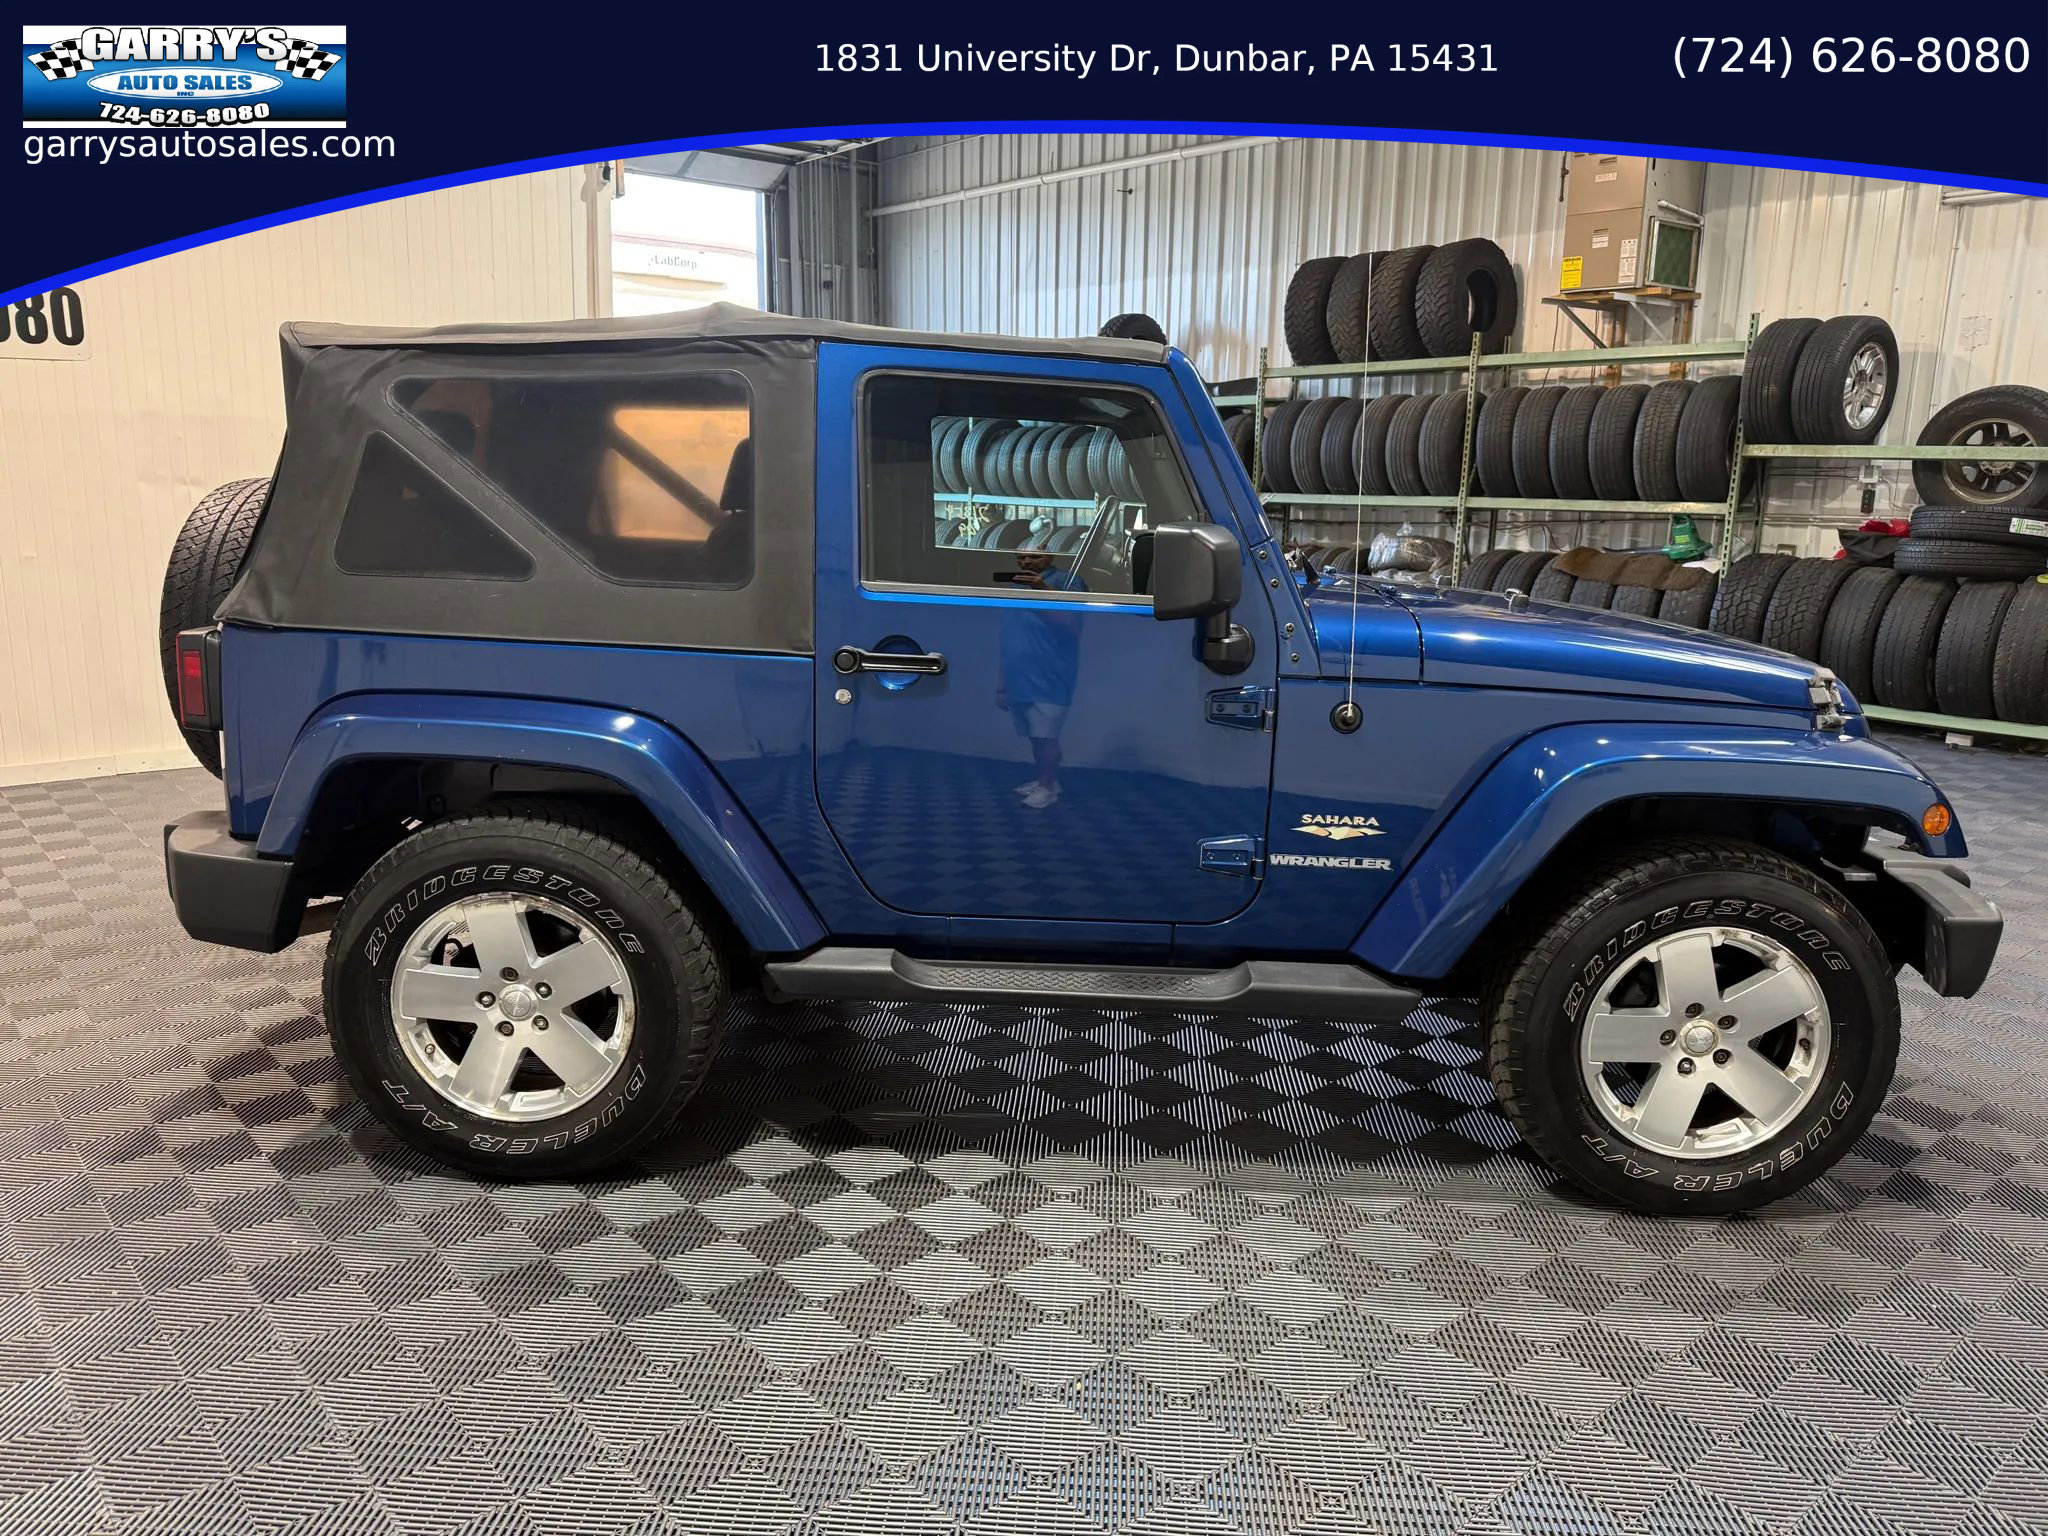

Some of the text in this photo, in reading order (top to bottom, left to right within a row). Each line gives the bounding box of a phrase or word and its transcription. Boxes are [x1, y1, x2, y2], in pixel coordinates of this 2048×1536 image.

[654, 254, 698, 271] LabCorp
[1269, 853, 1394, 872] WRANGLER
[1301, 813, 1381, 827] SAHARA
[364, 865, 645, 967] BRIDGESTONE
[1562, 900, 1852, 1022] BRIDGESTONE
[381, 1063, 648, 1155] DUELER A/T
[1581, 1081, 1854, 1192] DUELER A/T
